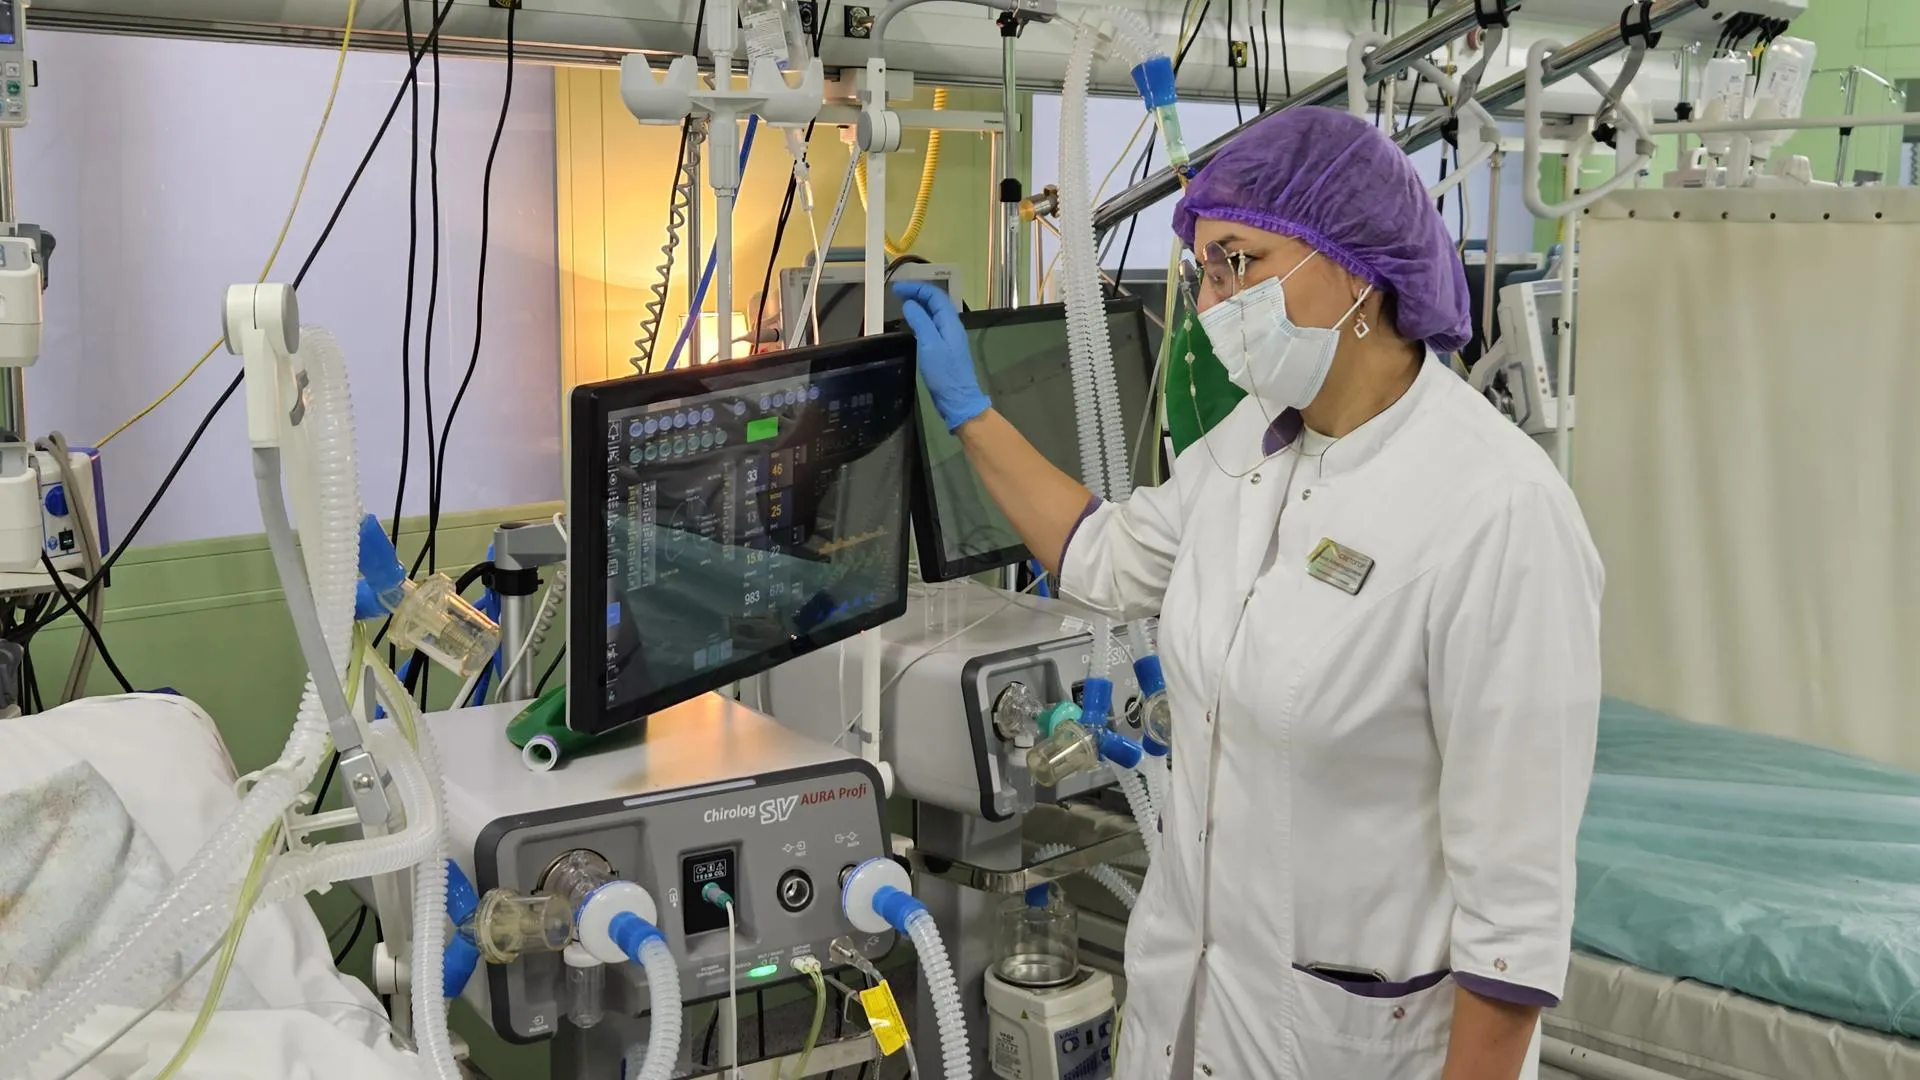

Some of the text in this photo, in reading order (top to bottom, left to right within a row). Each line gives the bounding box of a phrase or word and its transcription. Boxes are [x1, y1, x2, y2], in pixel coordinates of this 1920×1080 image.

[747, 469, 758, 482] 33
[772, 463, 783, 476] 46
[771, 504, 782, 518] 25
[704, 783, 867, 825] Chirolog SV AURA Profi
